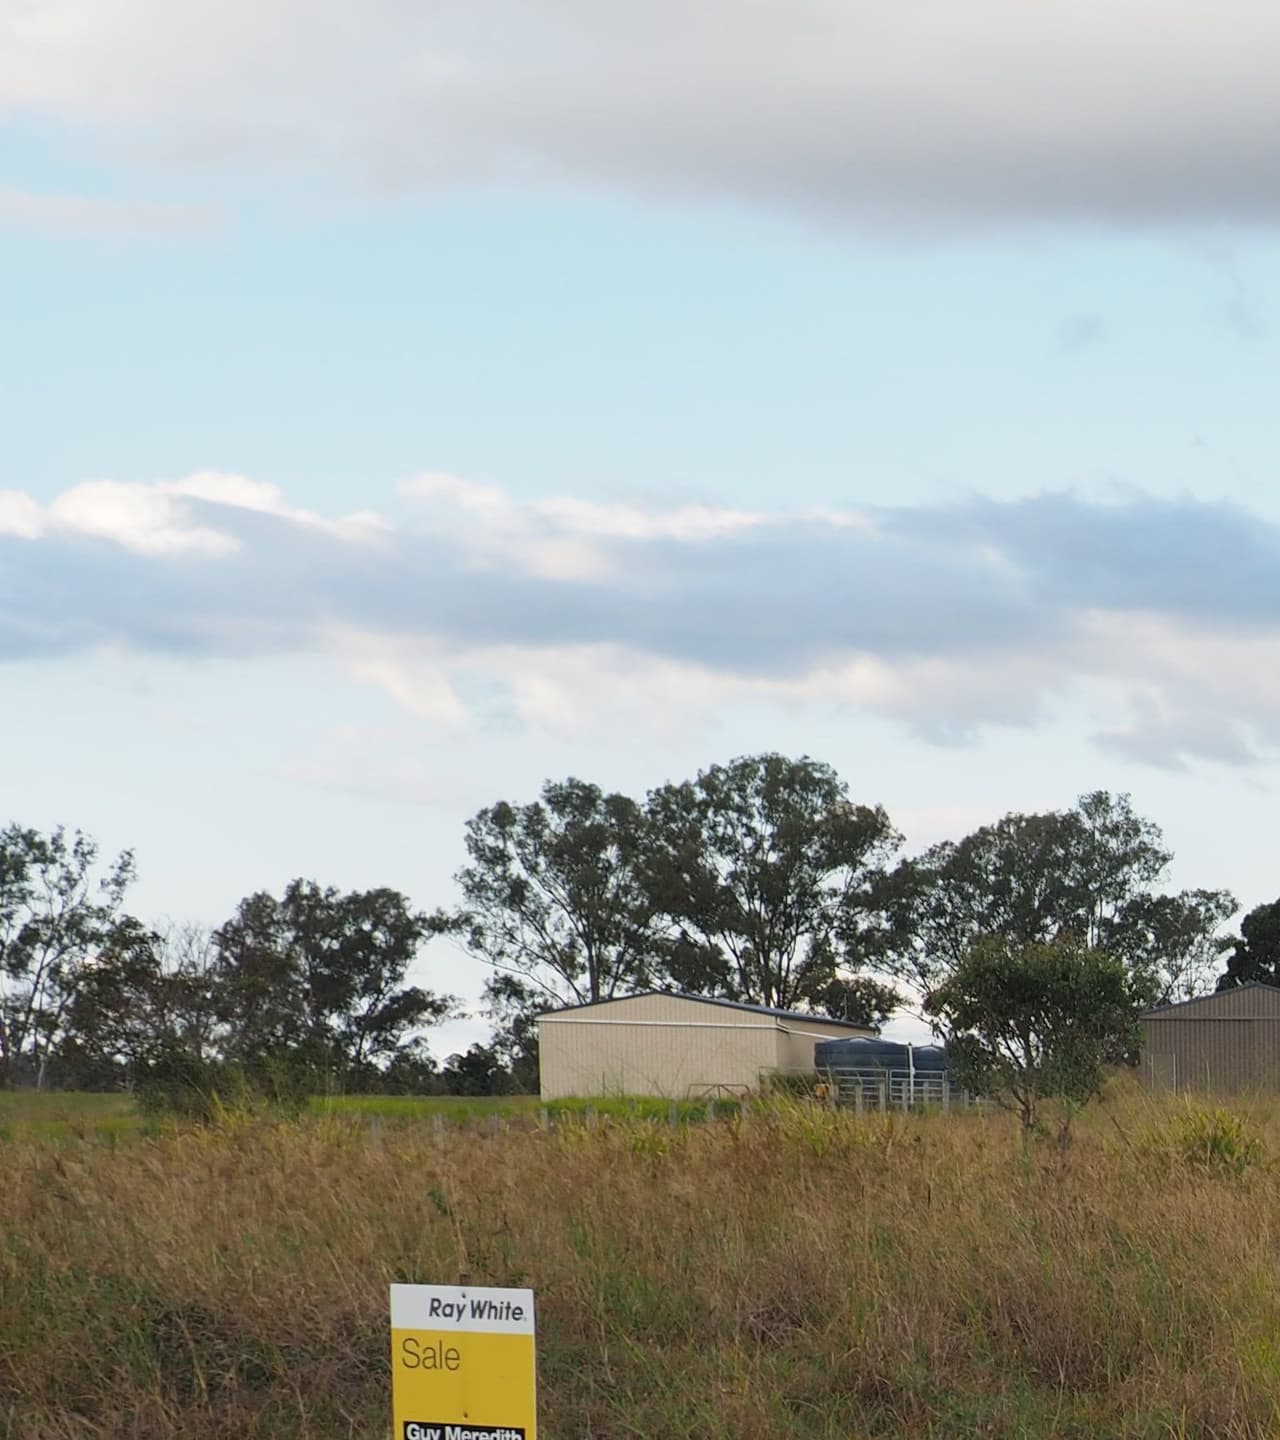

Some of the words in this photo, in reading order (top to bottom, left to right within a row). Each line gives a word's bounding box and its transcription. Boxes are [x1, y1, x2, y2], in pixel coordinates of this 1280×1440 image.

[428, 1297, 466, 1322] Ray
[470, 1299, 524, 1321] White
[402, 1338, 461, 1371] Sale
